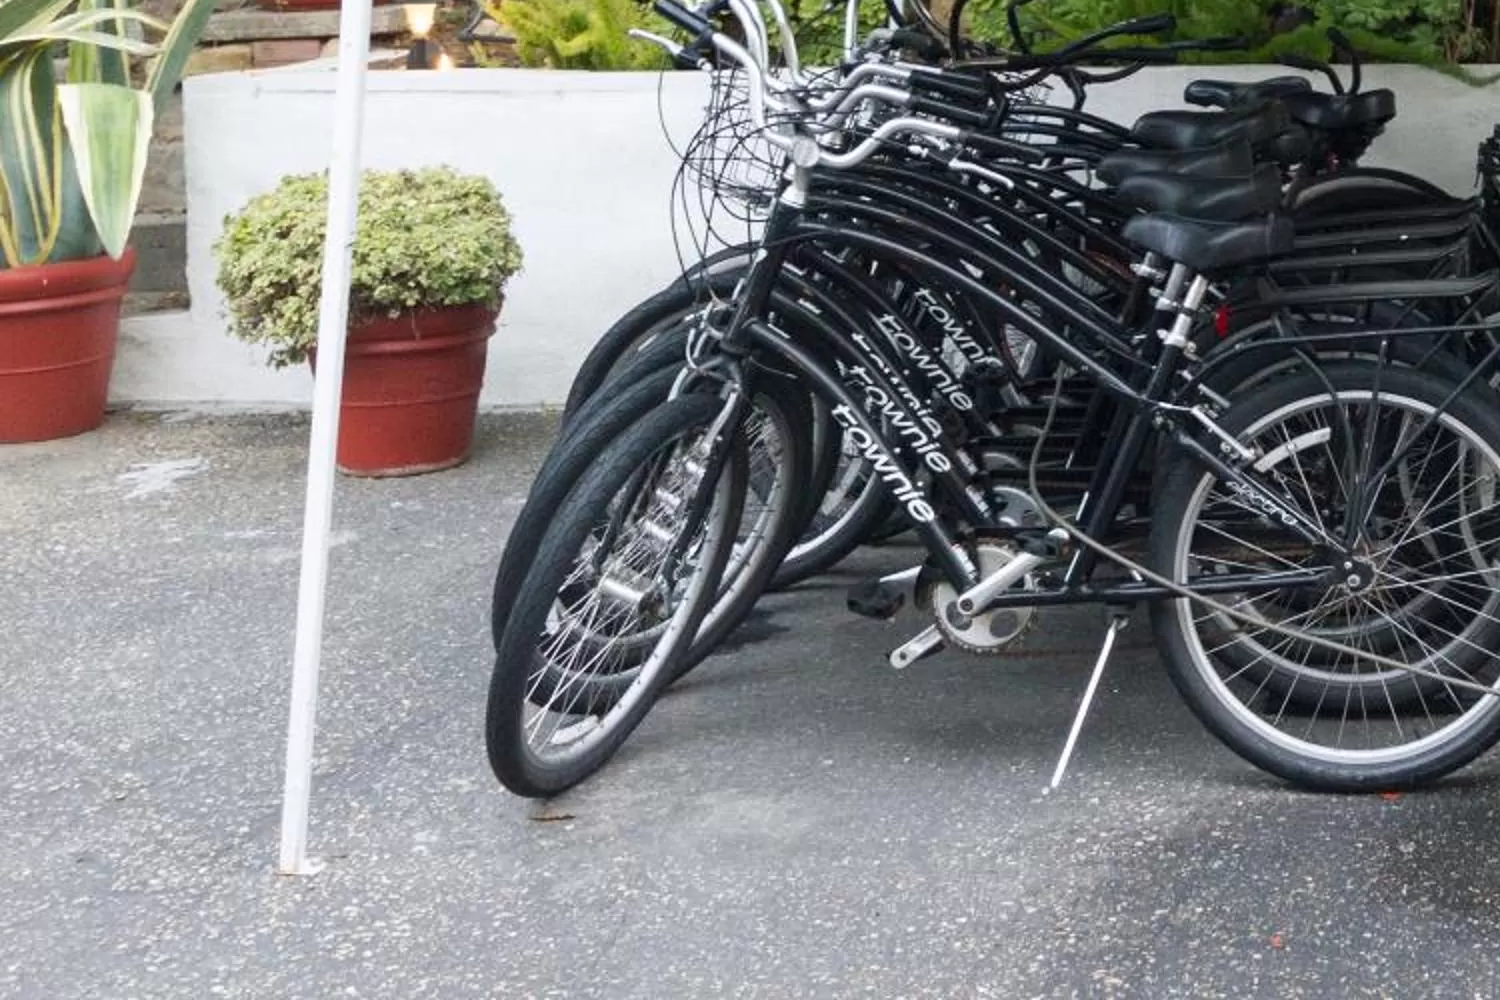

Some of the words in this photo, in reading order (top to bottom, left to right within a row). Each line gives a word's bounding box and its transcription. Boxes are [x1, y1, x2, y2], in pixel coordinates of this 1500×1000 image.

[880, 313, 973, 411] townie
[831, 403, 935, 522] townie
[850, 365, 950, 473] townie
